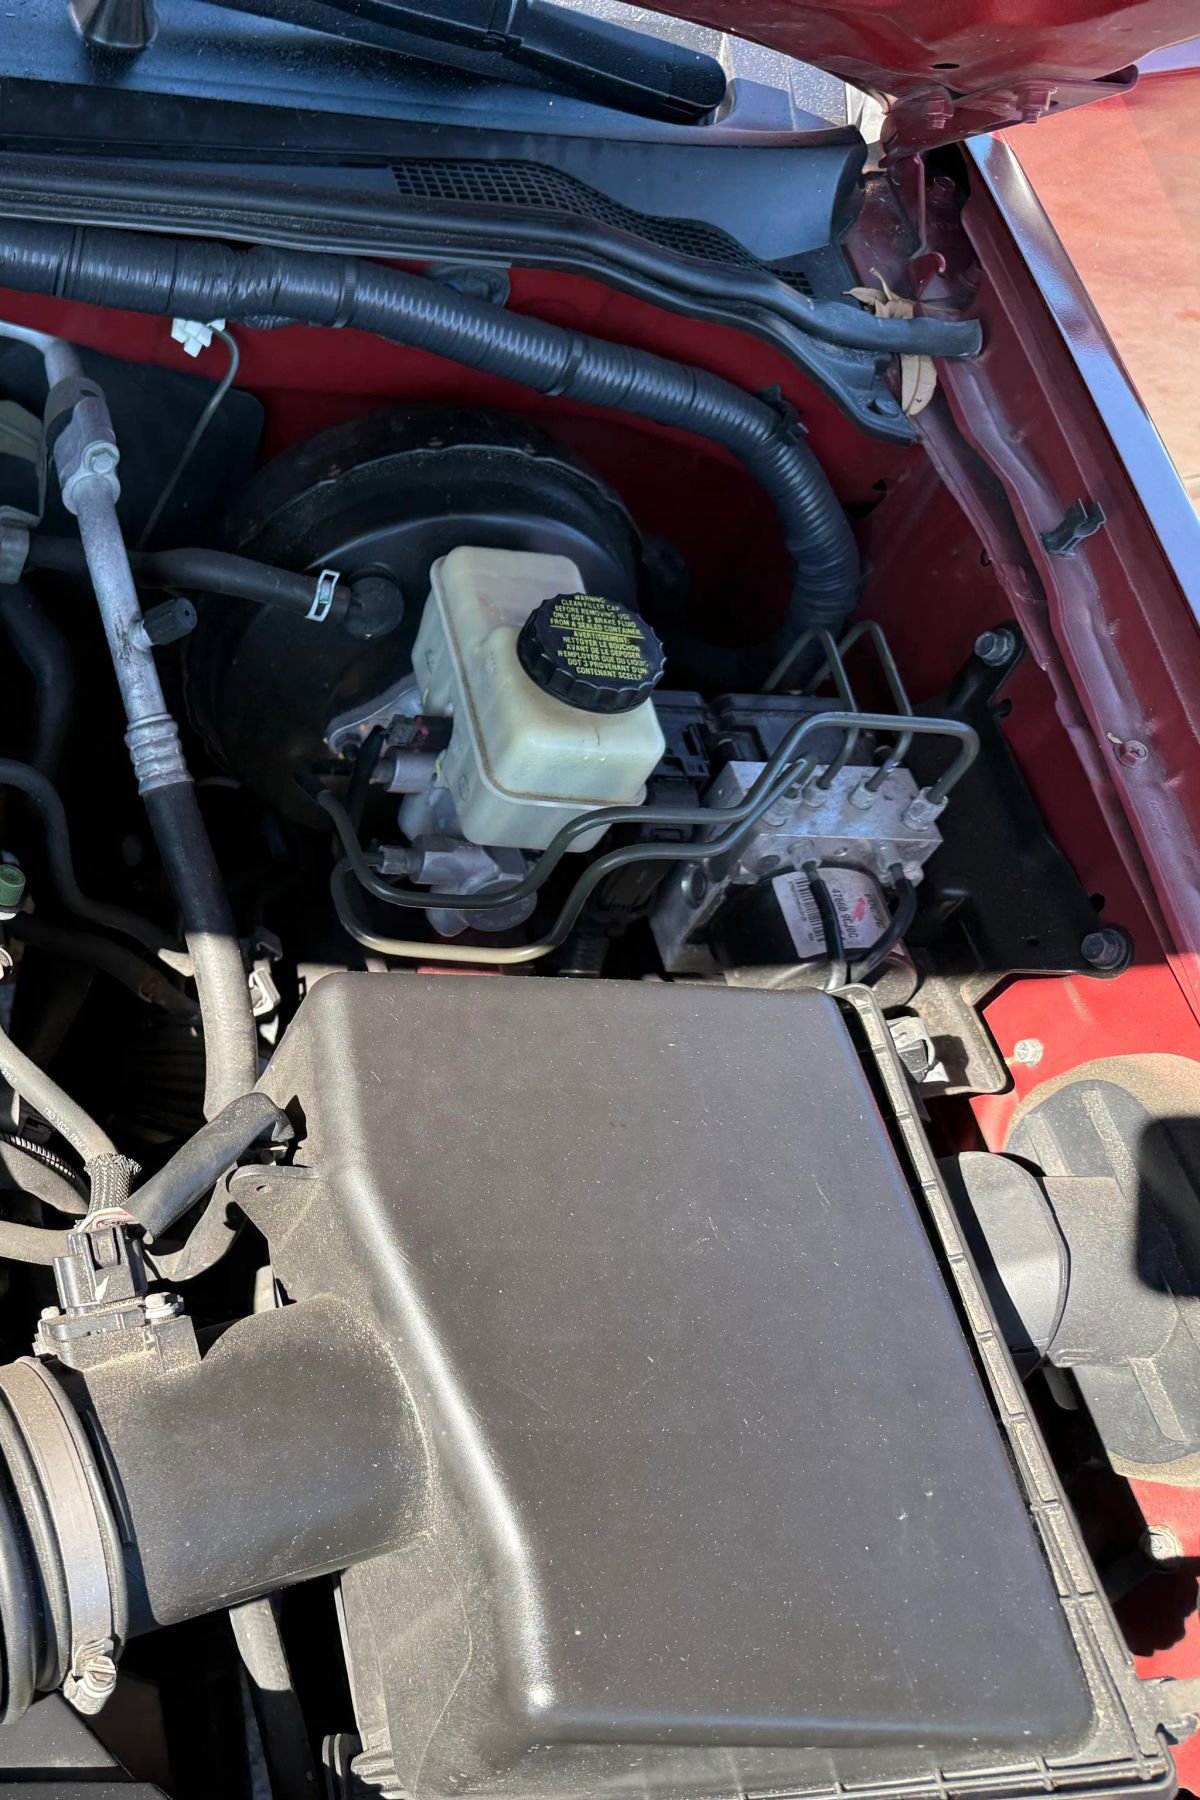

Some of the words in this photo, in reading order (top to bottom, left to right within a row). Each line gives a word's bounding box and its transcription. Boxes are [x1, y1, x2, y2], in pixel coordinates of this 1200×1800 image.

[555, 605, 579, 614] BEFORE
[561, 599, 584, 607] CLEAN
[584, 602, 605, 610] FILLER
[550, 618, 570, 626] FROM
[577, 621, 602, 630] SEALED
[594, 617, 616, 625] BRAKE
[563, 637, 598, 646] NETTOYER
[609, 642, 640, 651] BOUCHON
[566, 644, 589, 652] AVANT
[590, 661, 630, 671] PROVENANT
[576, 667, 616, 677] CONTENANT
[832, 888, 848, 912] 47660
